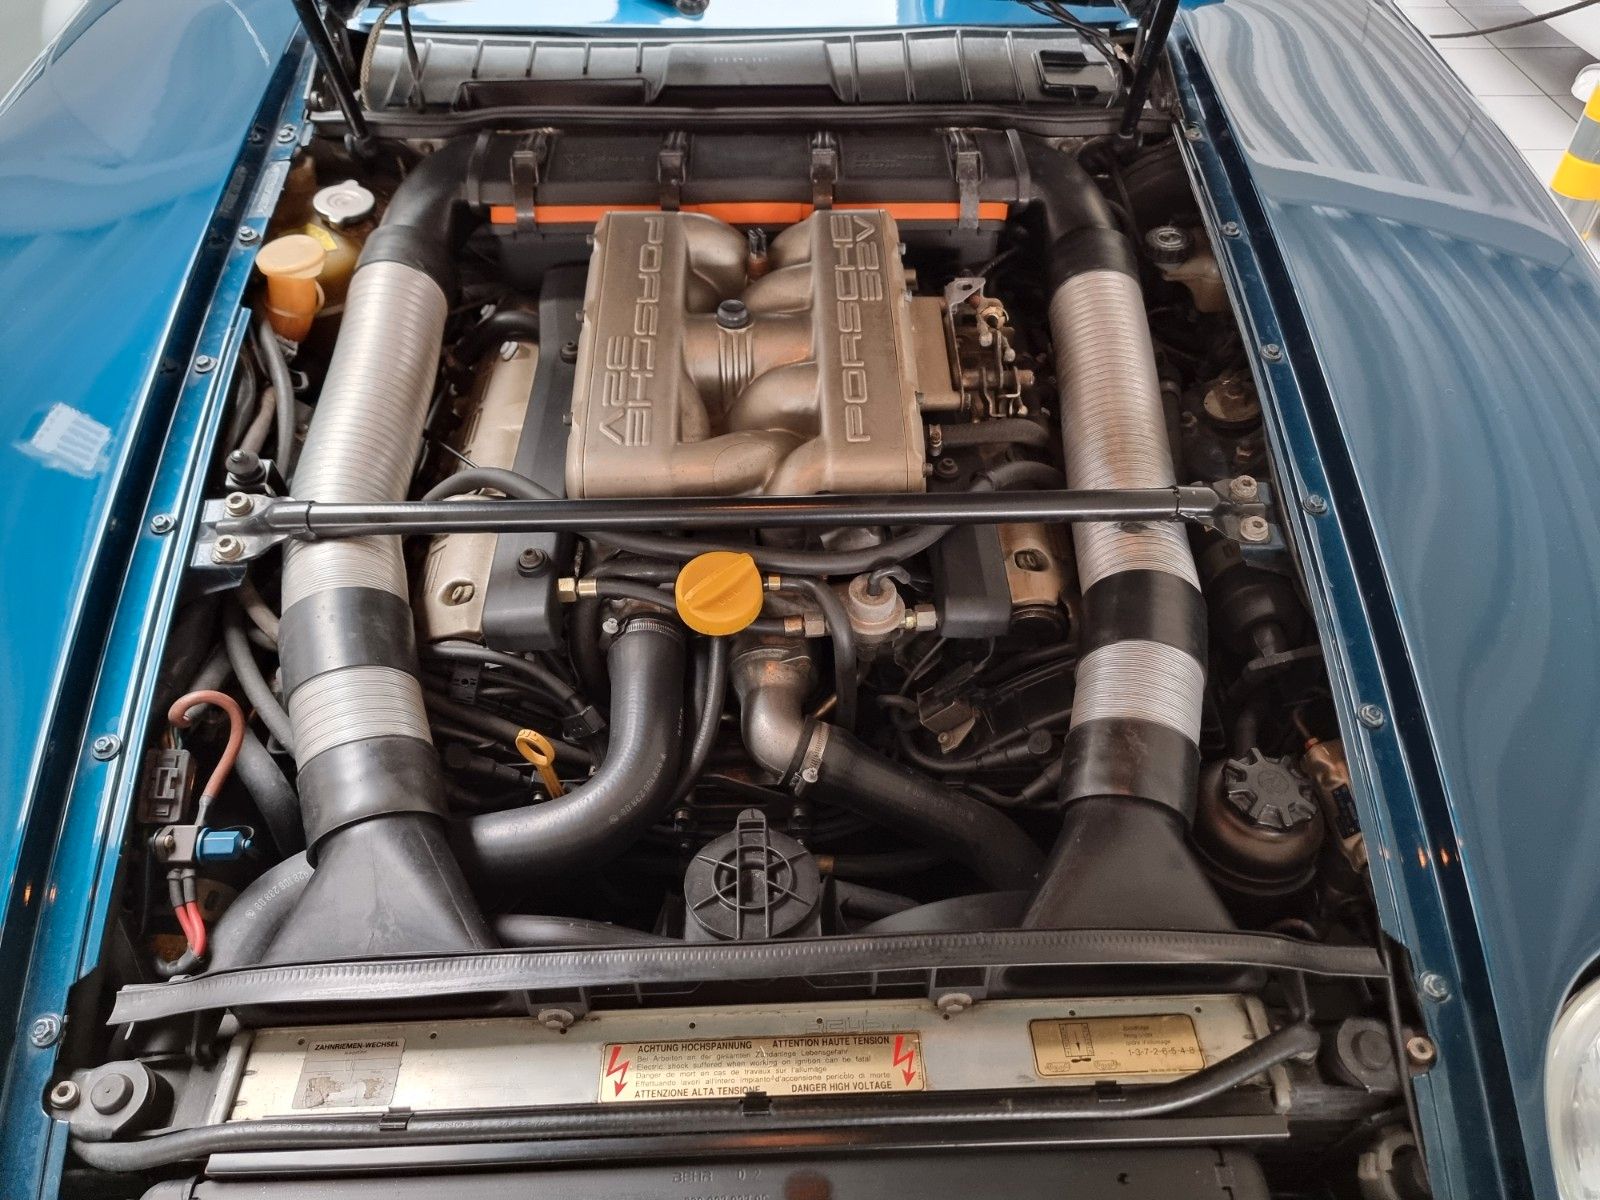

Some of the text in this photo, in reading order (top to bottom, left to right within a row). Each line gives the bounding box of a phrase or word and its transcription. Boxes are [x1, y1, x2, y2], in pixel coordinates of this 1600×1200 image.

[854, 215, 882, 302] 32V
[626, 216, 665, 447] PORSCHE
[830, 214, 872, 443] PORSCHE
[599, 335, 630, 446] 32V
[314, 1040, 400, 1050] ZAHNRIEMEN-WECHSEL
[638, 1041, 752, 1053] ACHTUNG HOCHSPANNUNG
[772, 1036, 890, 1048] ATTENTION HAUTE TENSION
[653, 1054, 682, 1062] Arbeiten
[717, 1052, 750, 1060] gesamten
[693, 1060, 722, 1069] suffered
[750, 1058, 778, 1066] working
[794, 1057, 820, 1066] ignition
[636, 1072, 661, 1080] Danger
[635, 1086, 760, 1098] ATTENZIONE ALTA TENSIONE
[792, 1081, 892, 1092] DANGER HIGH VOLTAGE
